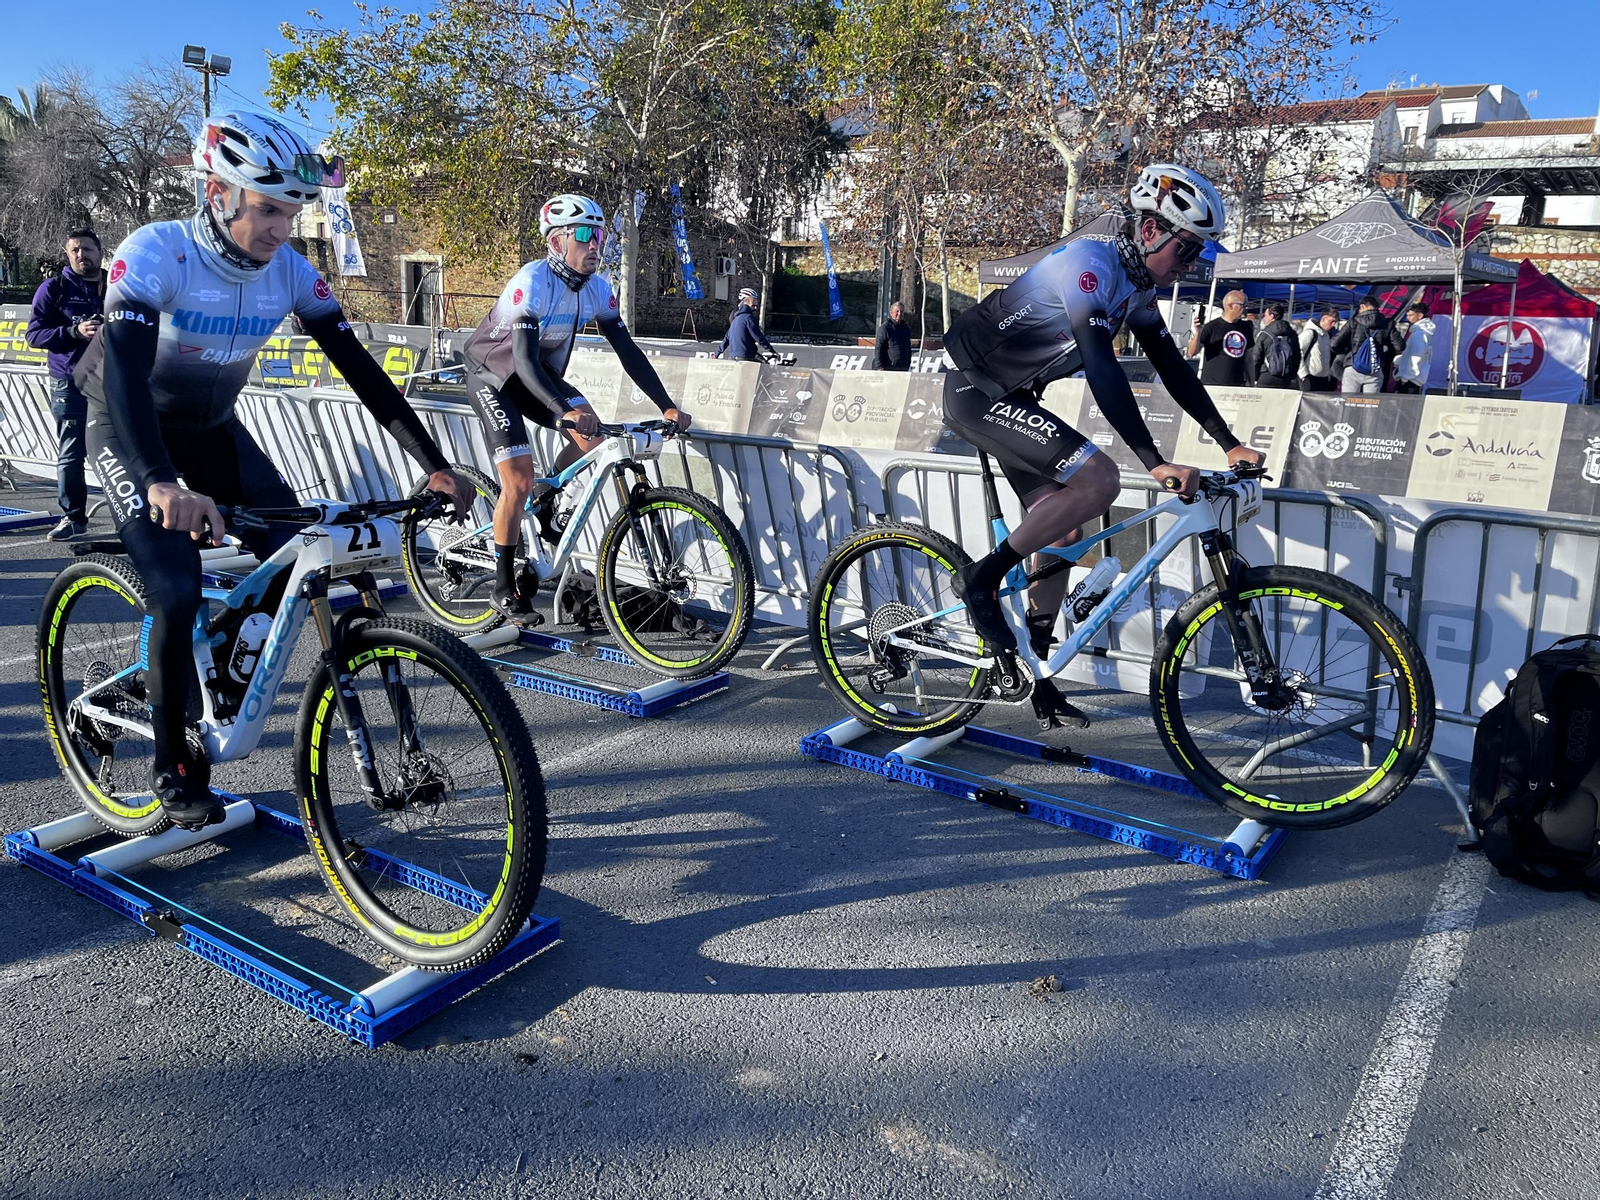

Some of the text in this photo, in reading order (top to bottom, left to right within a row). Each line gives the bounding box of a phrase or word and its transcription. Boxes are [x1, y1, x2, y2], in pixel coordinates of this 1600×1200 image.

[1298, 254, 1371, 275] FANTÉ
[1385, 255, 1437, 263] ENDURANCE
[171, 309, 283, 337] Klimatiz
[337, 321, 350, 331] SU
[998, 303, 1034, 331] GSPORT
[829, 354, 867, 370] BH
[983, 414, 1049, 445] RETAIL MAKERS
[1355, 444, 1404, 454] PROVINCIAL
[1356, 437, 1406, 447] DIPUTACIÓN
[1460, 436, 1546, 460] Andalucía
[1361, 451, 1392, 460] HUELVA
[1330, 480, 1345, 488] UCI
[343, 522, 382, 553] 21
[853, 532, 896, 549] PIRELLI
[1386, 635, 1418, 710] SCORPION
[1160, 689, 1179, 745] PIRELLI
[312, 836, 360, 914] SCORPION
